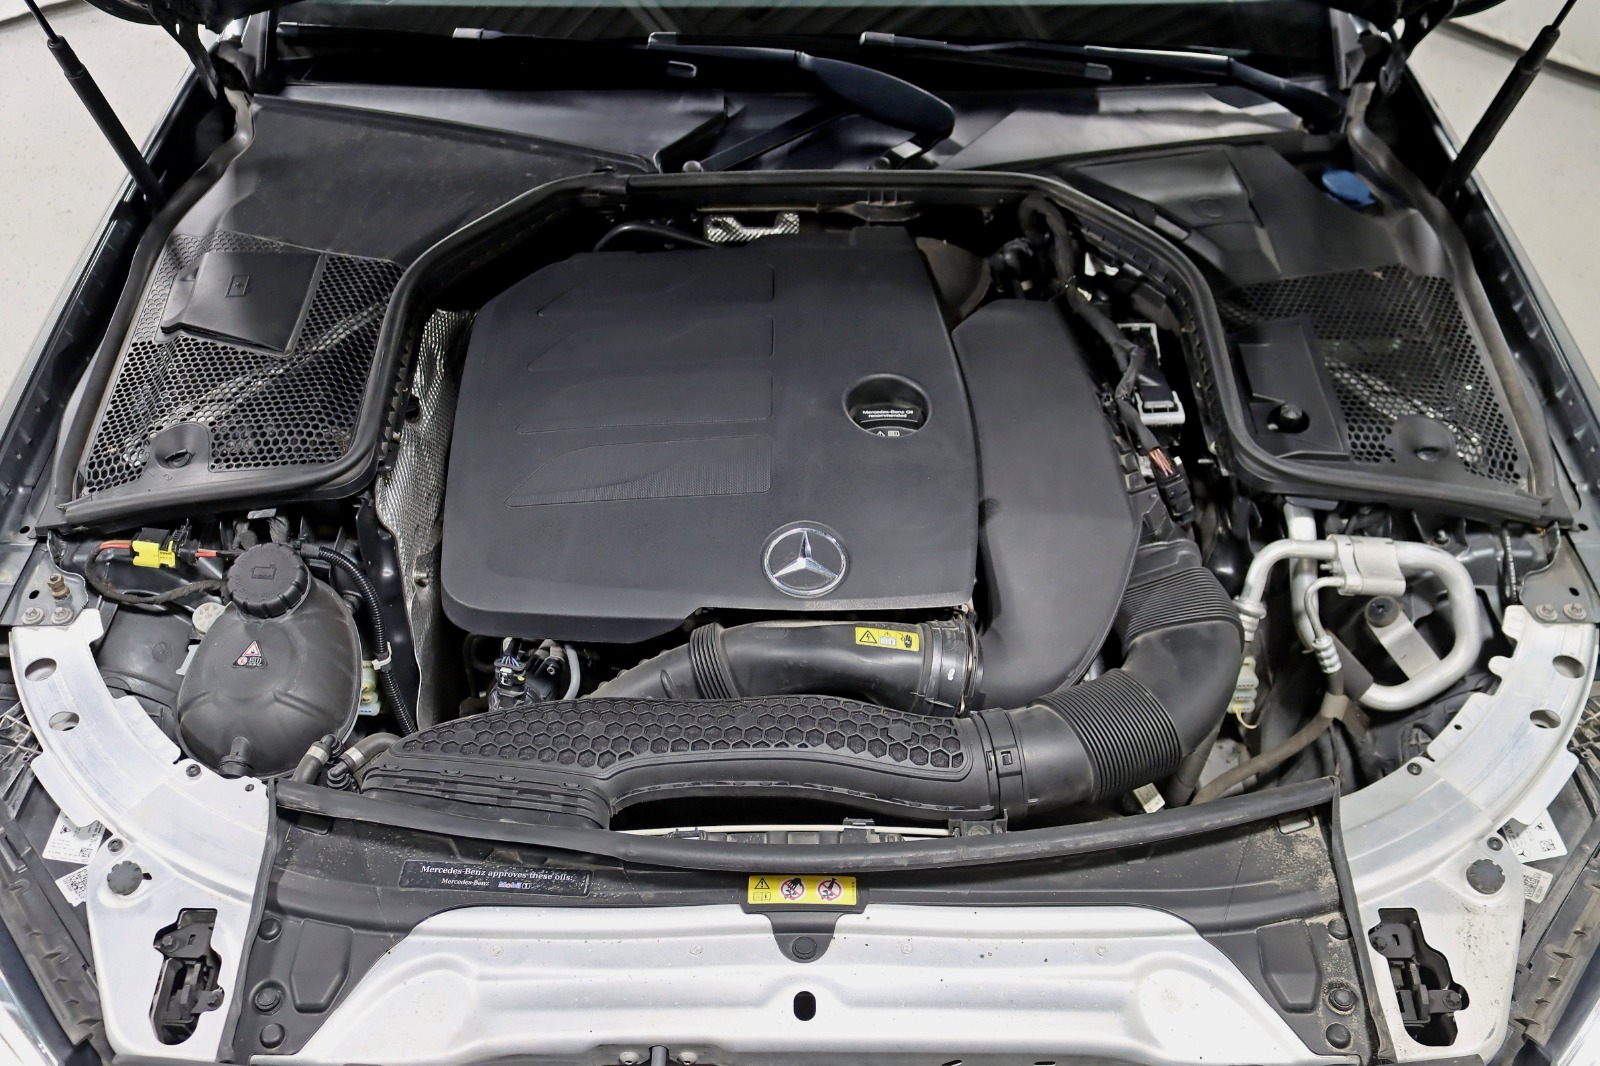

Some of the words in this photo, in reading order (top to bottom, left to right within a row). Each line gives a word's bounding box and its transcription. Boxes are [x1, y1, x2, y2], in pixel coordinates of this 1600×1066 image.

[421, 865, 486, 876] Mercedes-Benz
[488, 870, 526, 879] approves
[529, 871, 552, 880] these
[441, 878, 489, 886] Mercedes-Benz
[498, 881, 522, 889] Mobil
